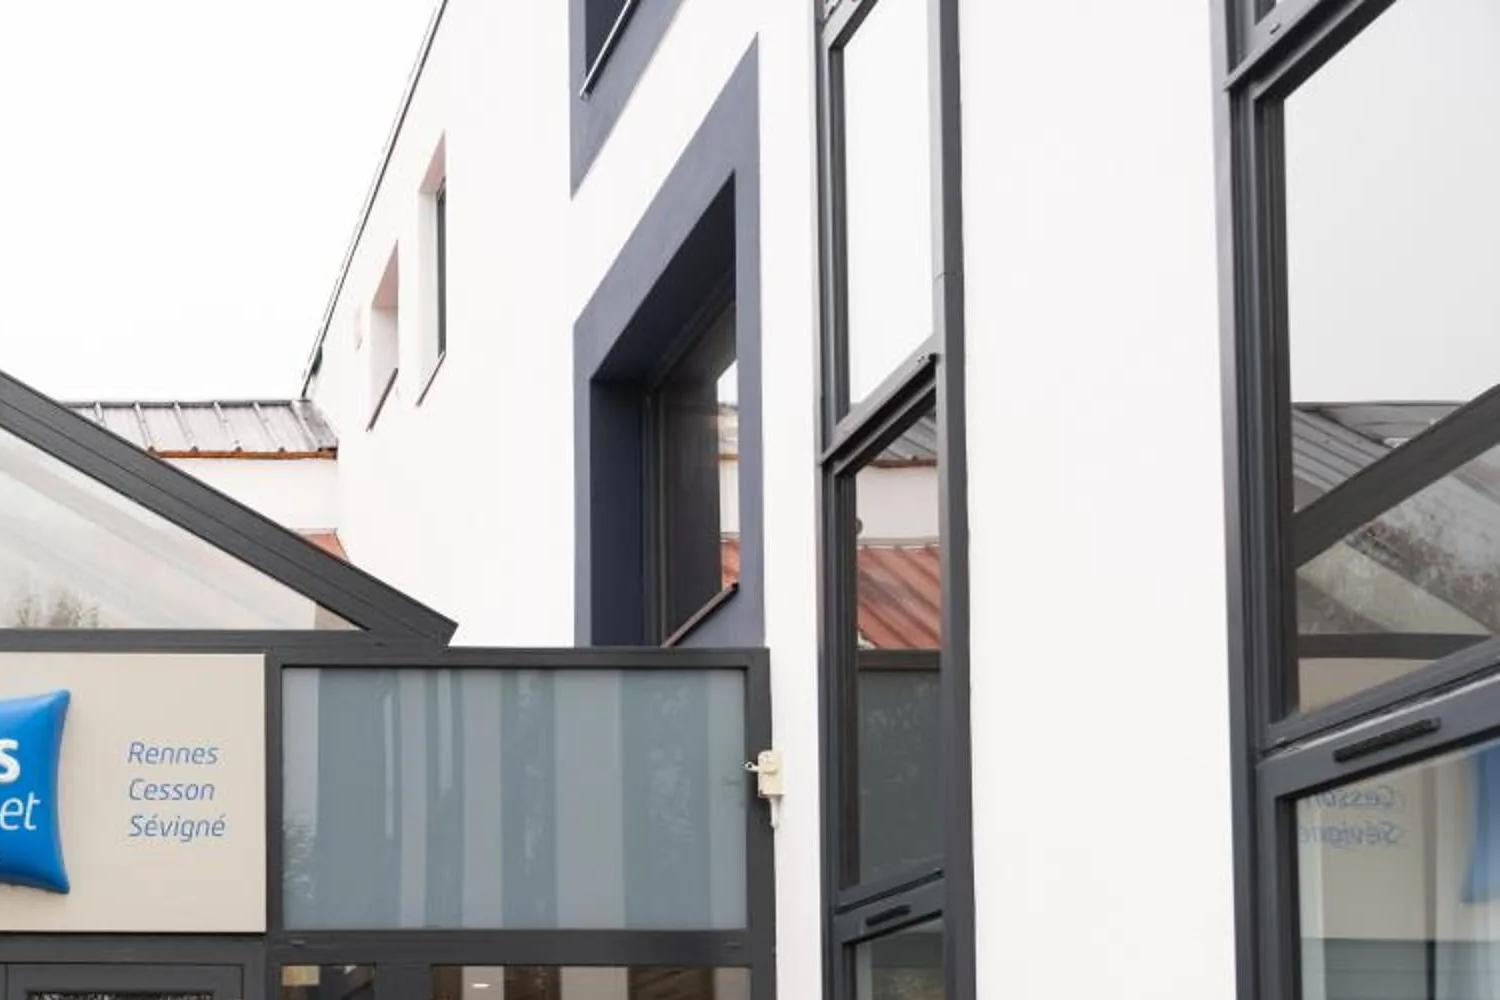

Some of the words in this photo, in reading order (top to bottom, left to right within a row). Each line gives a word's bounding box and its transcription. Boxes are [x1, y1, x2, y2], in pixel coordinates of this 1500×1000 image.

[127, 742, 219, 765] Rennes
[129, 778, 214, 801] Cesson
[129, 814, 225, 842] Sévigné
